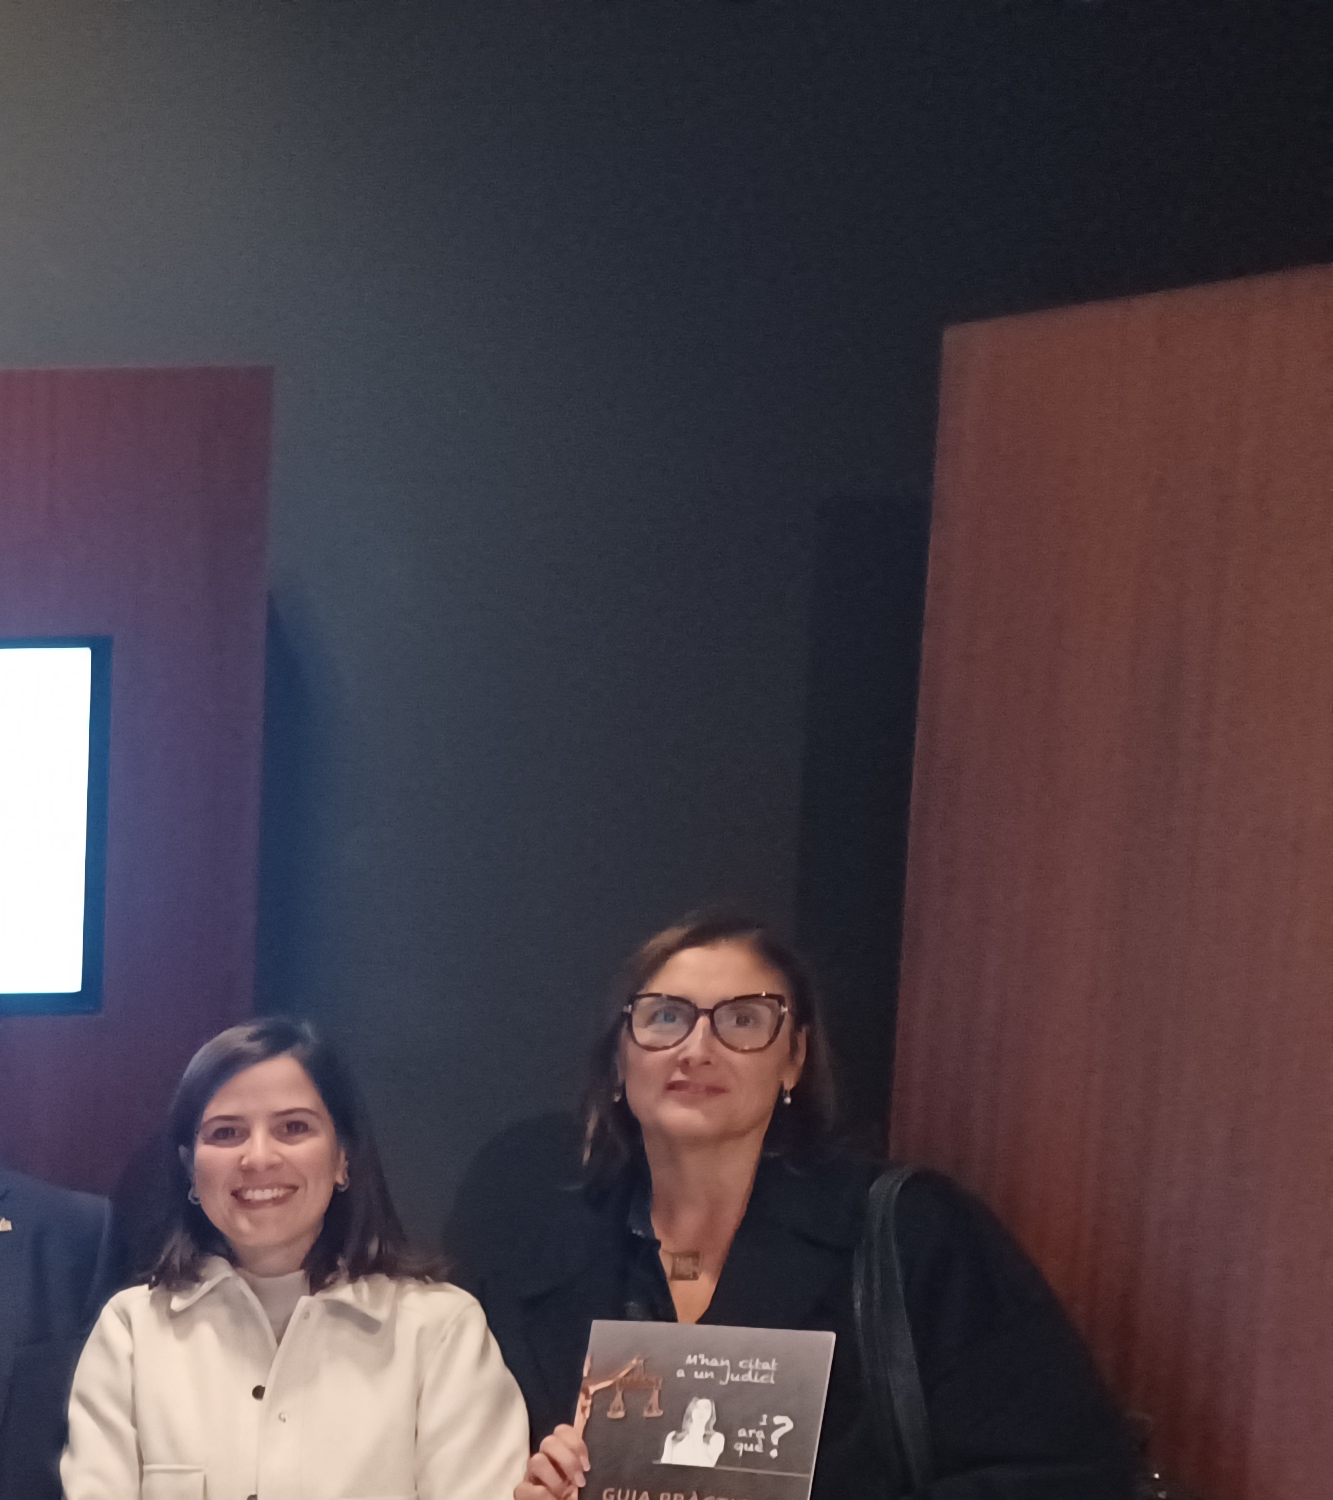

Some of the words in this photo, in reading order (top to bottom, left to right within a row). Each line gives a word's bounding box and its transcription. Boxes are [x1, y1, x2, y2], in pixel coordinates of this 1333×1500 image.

[739, 1358, 778, 1370] citat
[676, 1369, 685, 1377] a
[694, 1370, 714, 1379] un
[738, 1428, 765, 1439] ara
